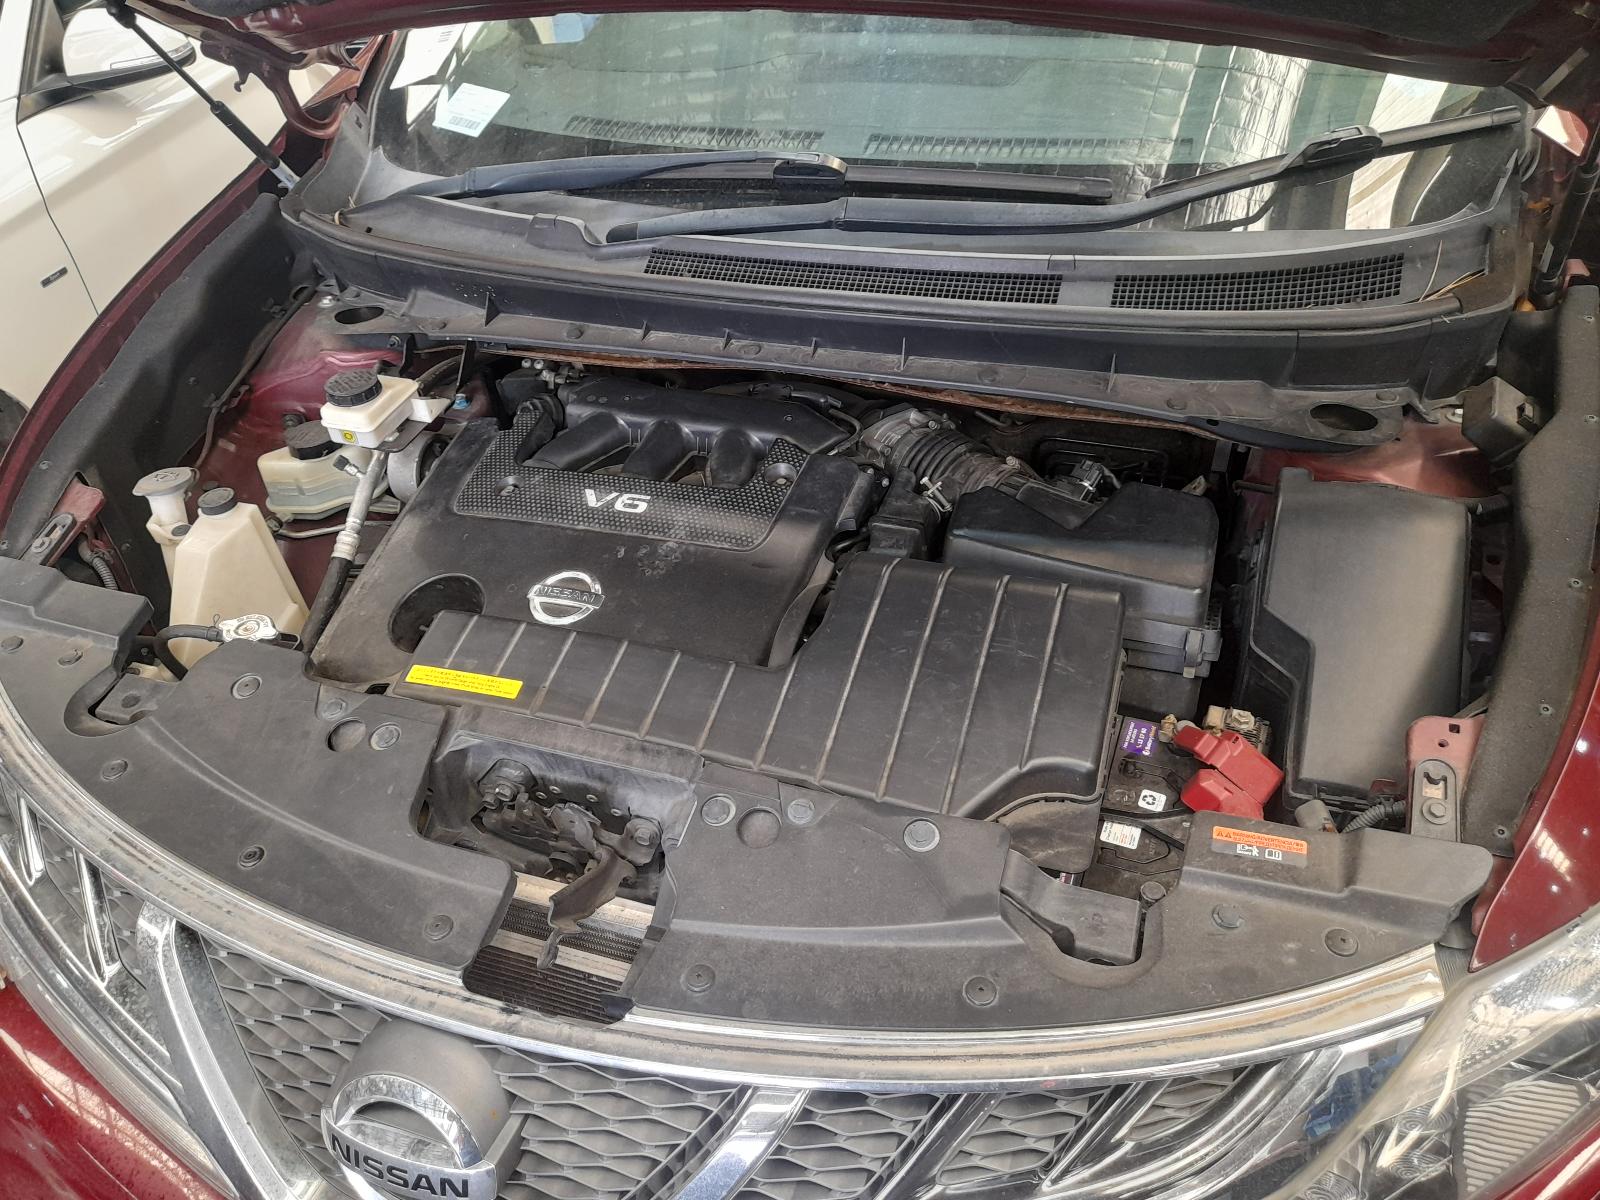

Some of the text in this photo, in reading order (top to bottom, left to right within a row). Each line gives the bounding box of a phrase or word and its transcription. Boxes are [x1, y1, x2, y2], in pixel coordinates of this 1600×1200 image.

[584, 488, 651, 514] V6
[533, 587, 596, 603] NISSAN
[331, 1133, 469, 1198] NISSAN
